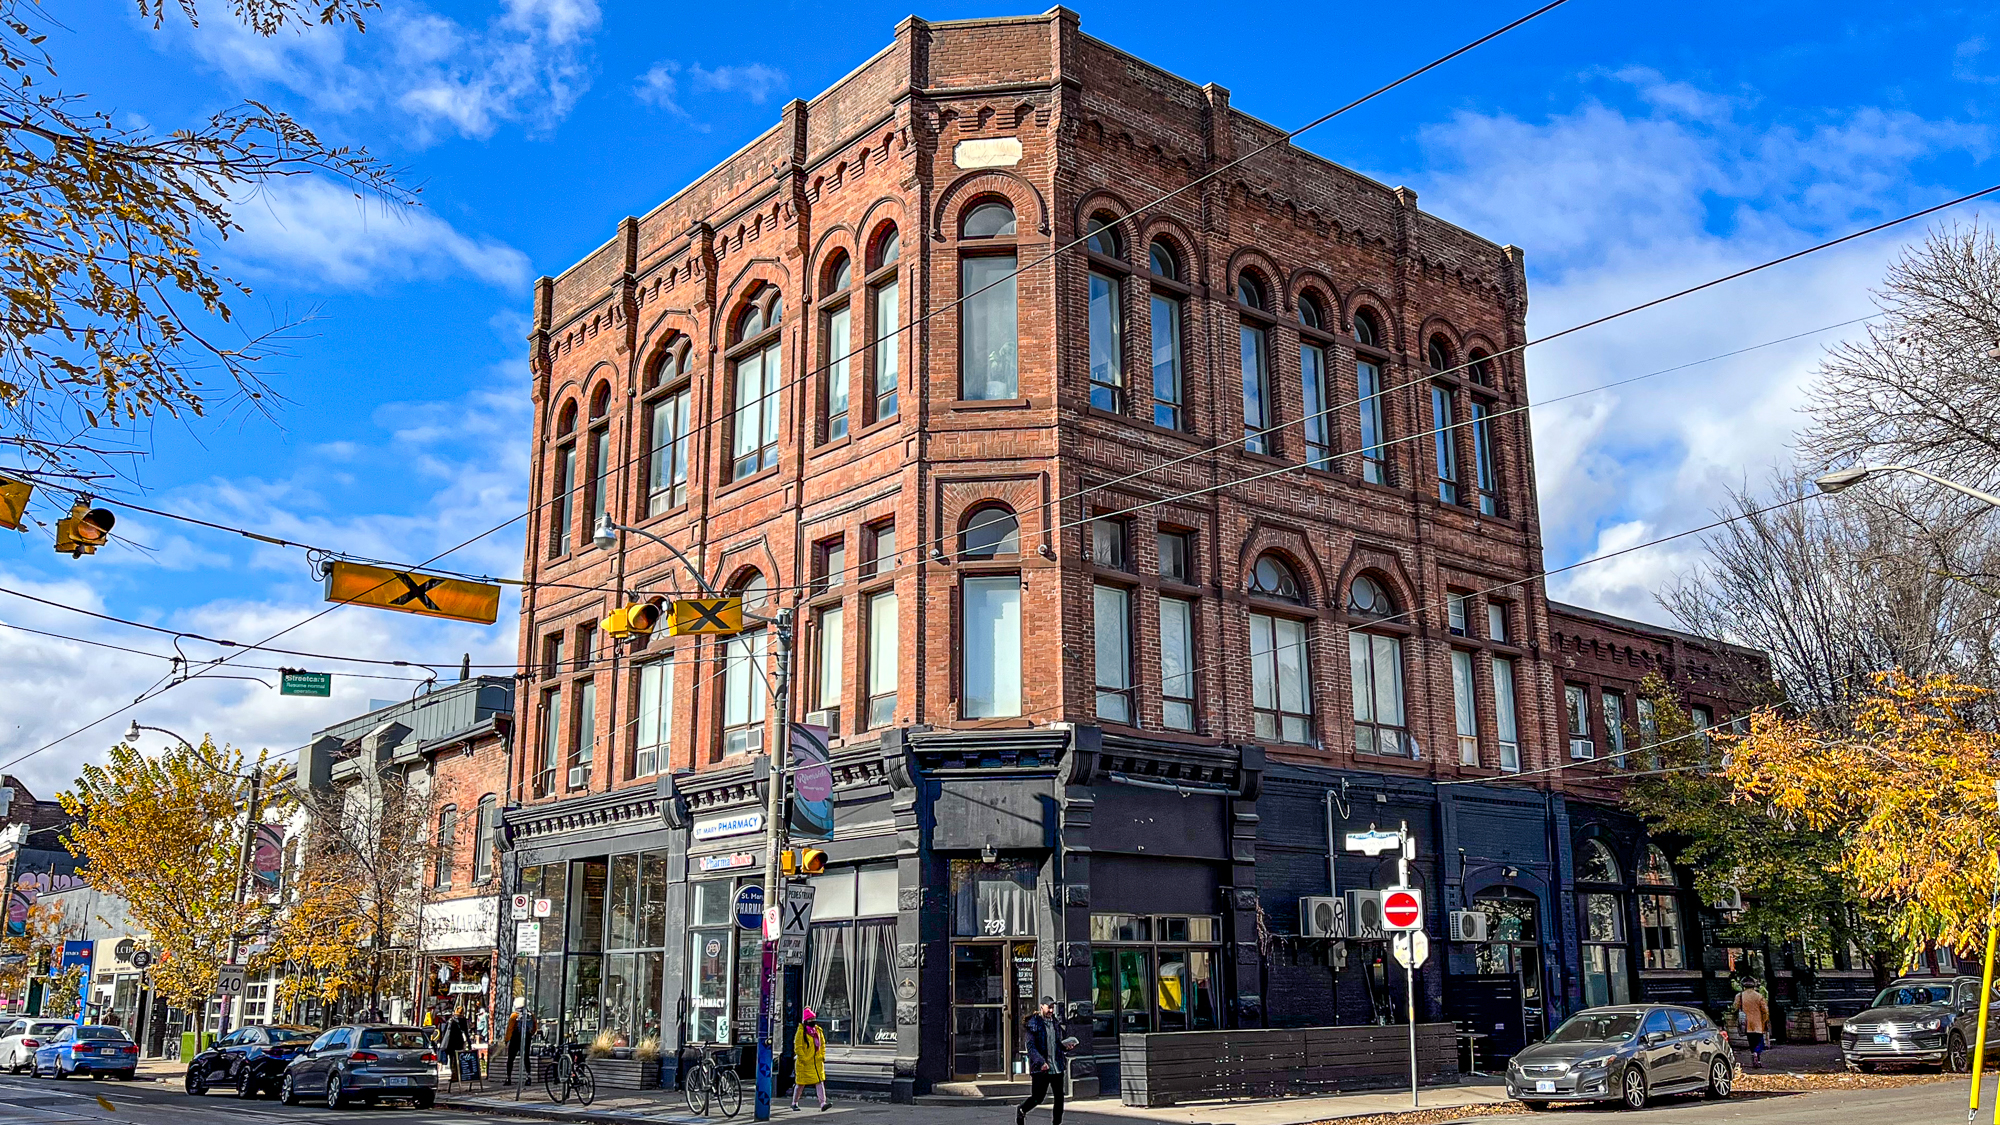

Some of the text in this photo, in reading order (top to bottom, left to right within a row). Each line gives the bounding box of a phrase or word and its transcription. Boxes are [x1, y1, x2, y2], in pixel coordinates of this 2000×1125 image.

[796, 769, 827, 784] Riverside
[703, 826, 717, 834] MARY
[718, 817, 758, 832] PHARMACY
[984, 919, 1006, 935] 798
[219, 977, 241, 991] 40
[692, 998, 725, 1008] PHARMACY
